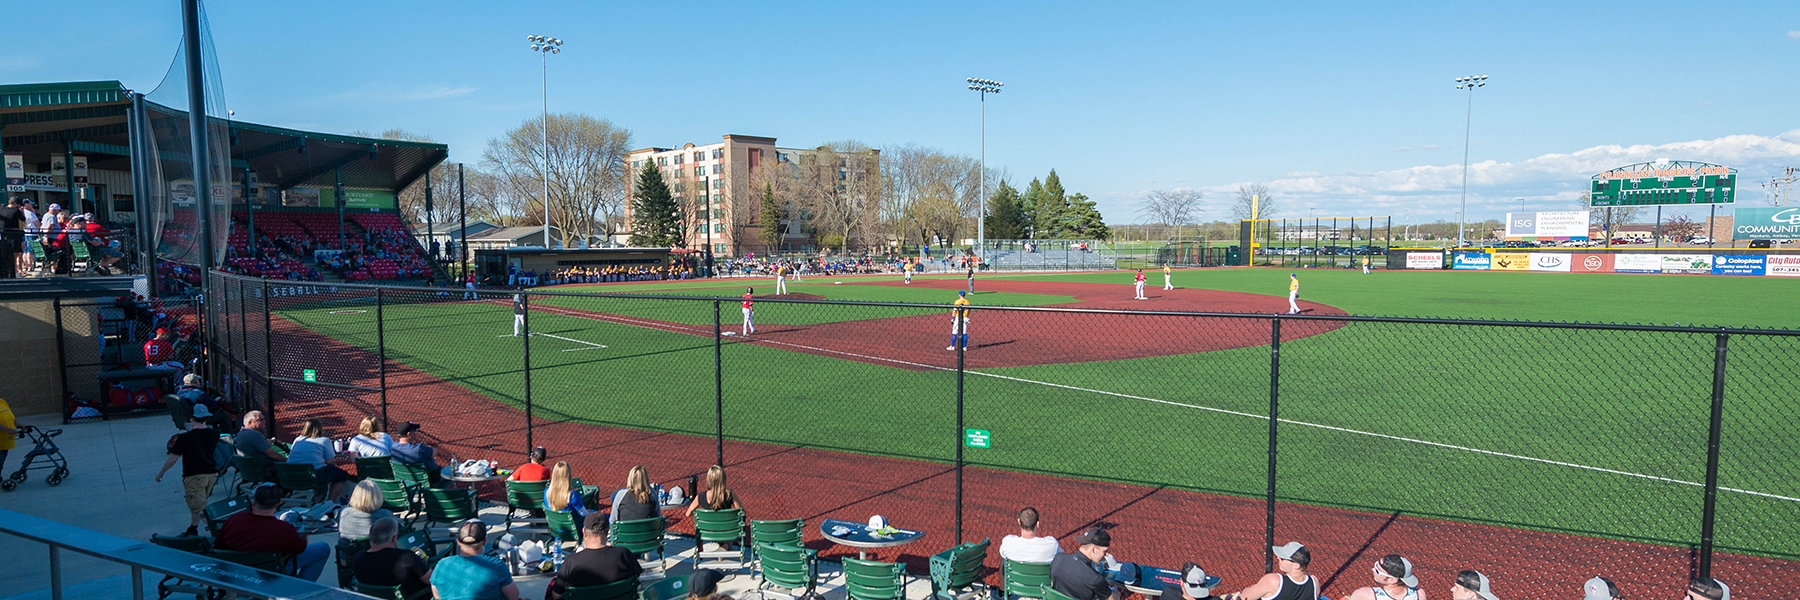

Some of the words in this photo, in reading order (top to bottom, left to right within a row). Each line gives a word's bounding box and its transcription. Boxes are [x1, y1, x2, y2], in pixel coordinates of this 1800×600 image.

[1600, 170, 1649, 179] FRANKLIN
[1654, 168, 1696, 176] ROGERS
[1700, 166, 1729, 175] PARK
[24, 174, 54, 185] PRESS
[1514, 219, 1532, 228] ISG
[1540, 255, 1560, 264] CHS
[1768, 256, 1784, 265] City
[1784, 256, 1800, 265] Auto
[148, 345, 159, 355] 13
